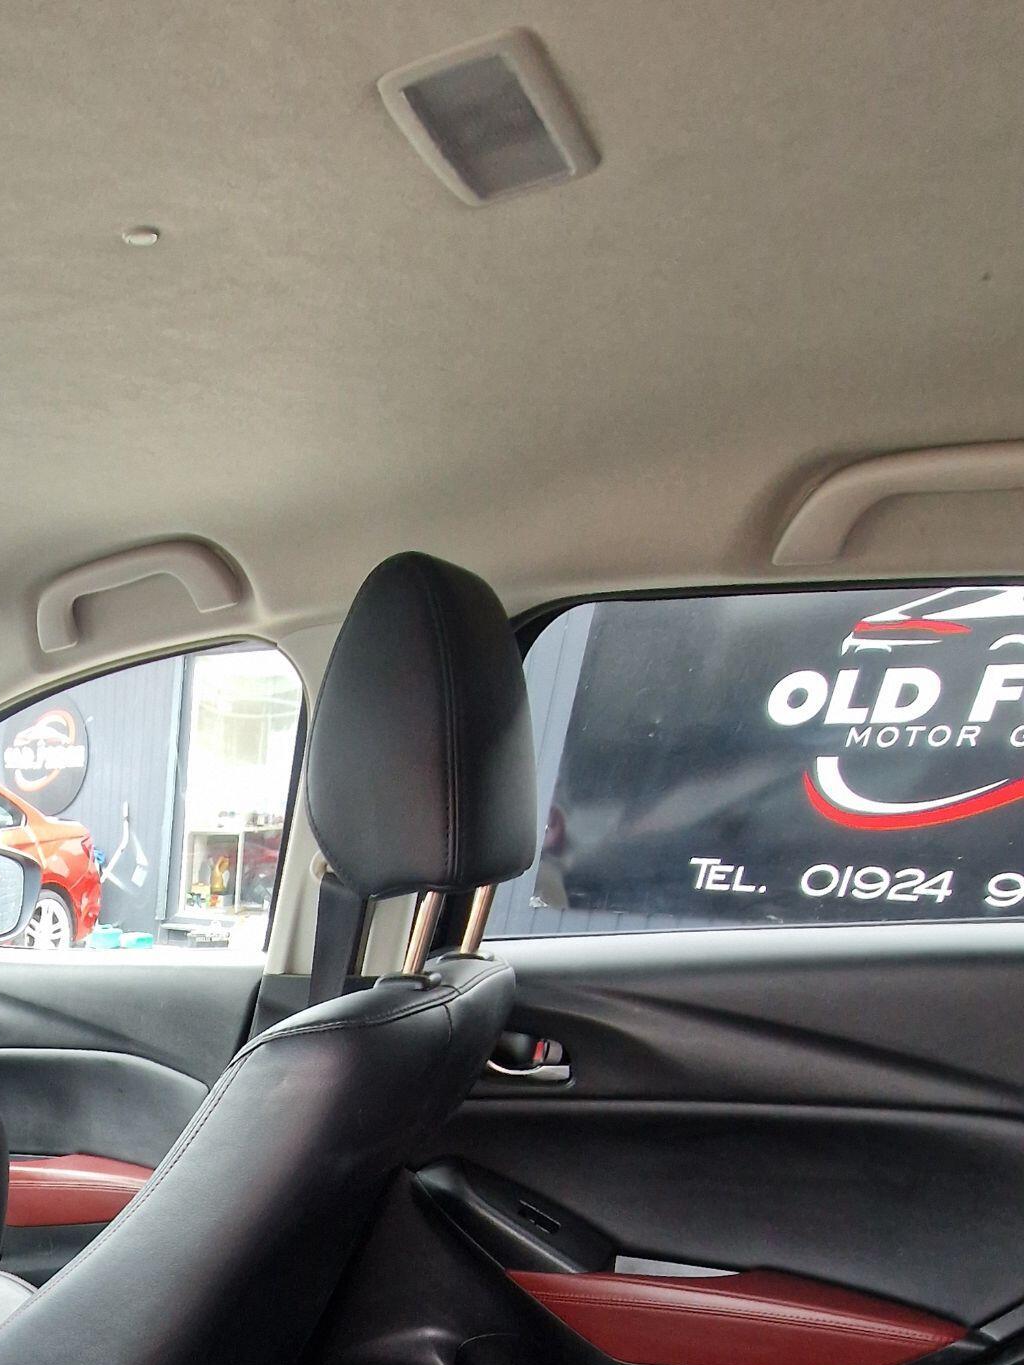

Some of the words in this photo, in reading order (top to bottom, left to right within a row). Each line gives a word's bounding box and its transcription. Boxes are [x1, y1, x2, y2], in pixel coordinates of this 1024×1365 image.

[767, 666, 942, 727] OLD
[967, 663, 1024, 723] F
[844, 724, 982, 749] MOTOR
[689, 857, 767, 894] TEL.
[800, 863, 955, 903] 01924
[984, 872, 1024, 908] 9
